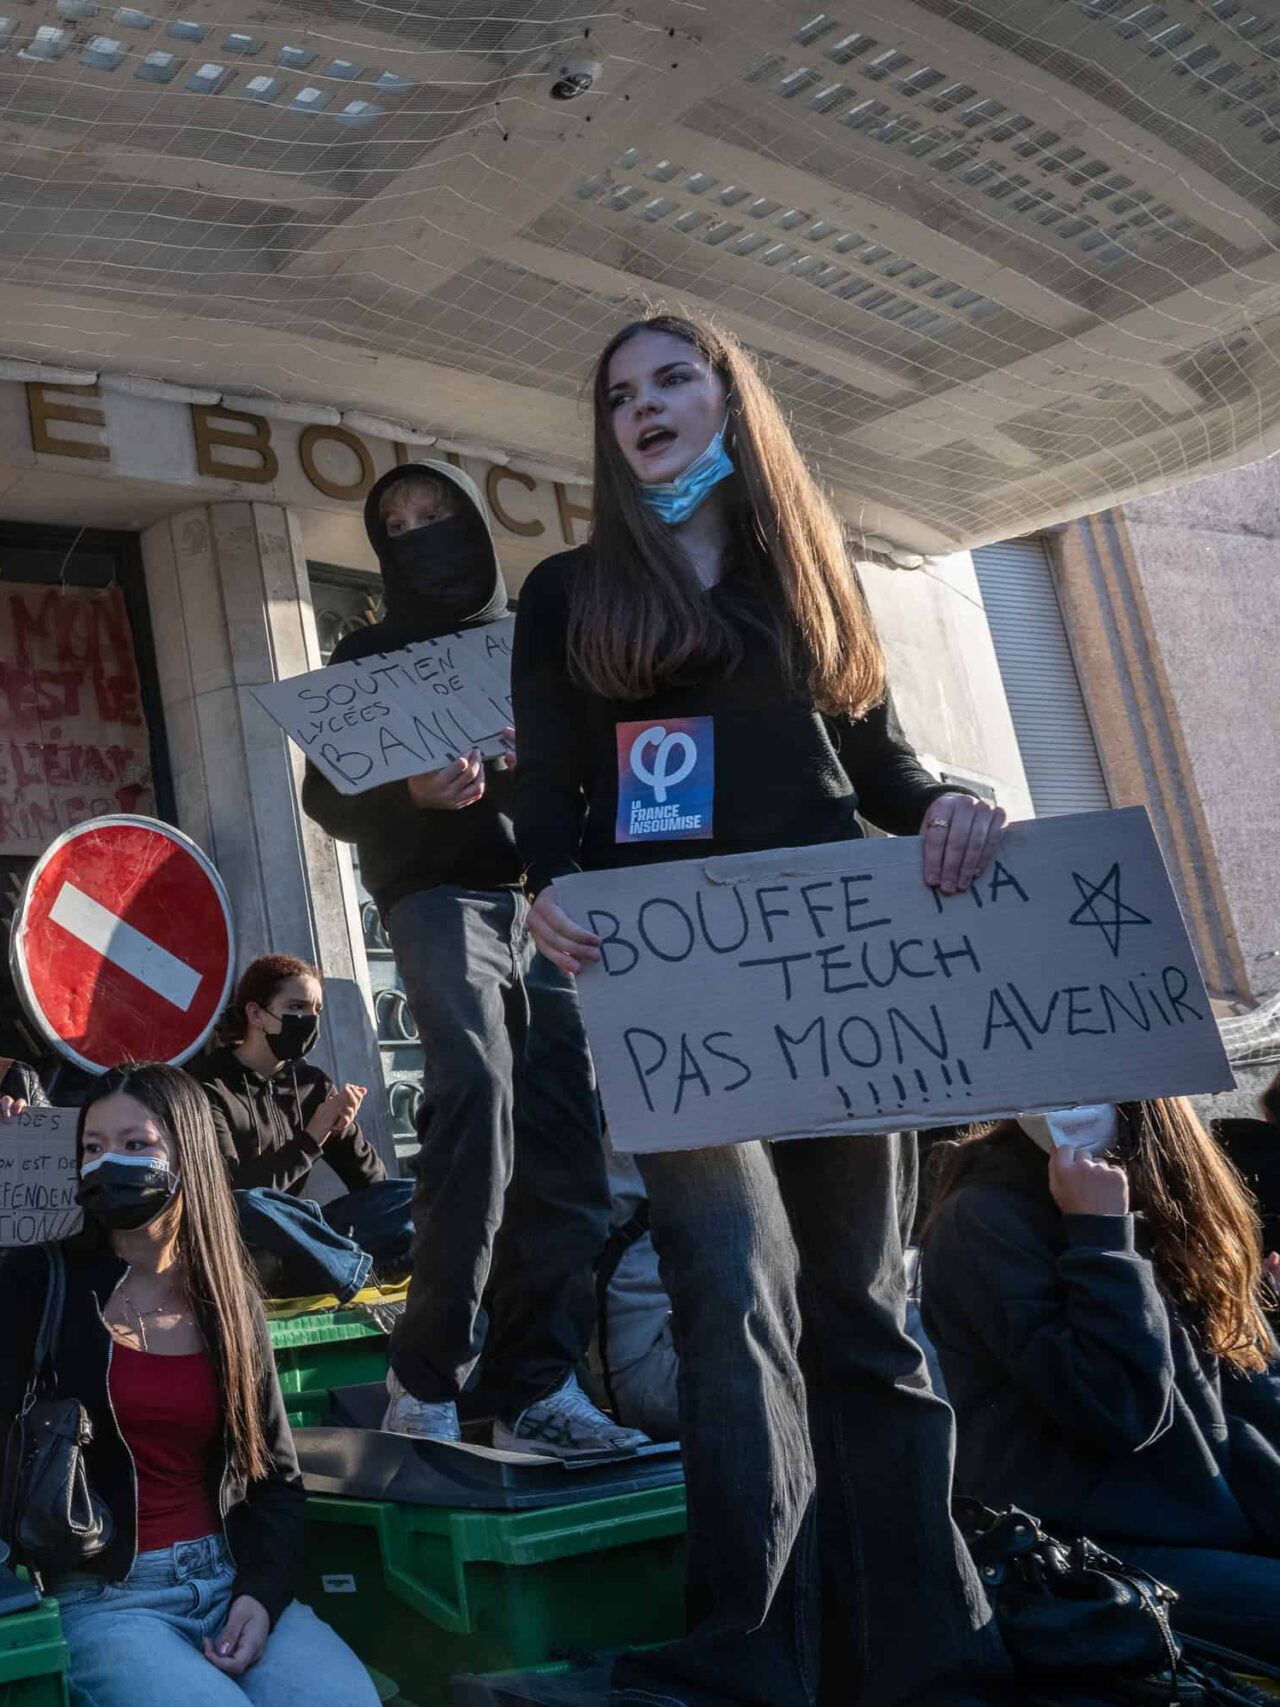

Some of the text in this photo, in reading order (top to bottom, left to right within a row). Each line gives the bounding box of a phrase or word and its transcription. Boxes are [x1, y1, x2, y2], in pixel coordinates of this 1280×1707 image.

[298, 675, 464, 745] LYCÉES DE
[631, 799, 642, 810] LA
[631, 804, 680, 822] FRANCE
[629, 815, 701, 835] INSOUMISE
[587, 874, 892, 977] BOUFFE
[738, 934, 981, 1001] TEUCH
[623, 1026, 752, 1113] PAS
[773, 1004, 947, 1080] MON
[17, 1112, 61, 1130] DES
[22, 1155, 52, 1170] EST
